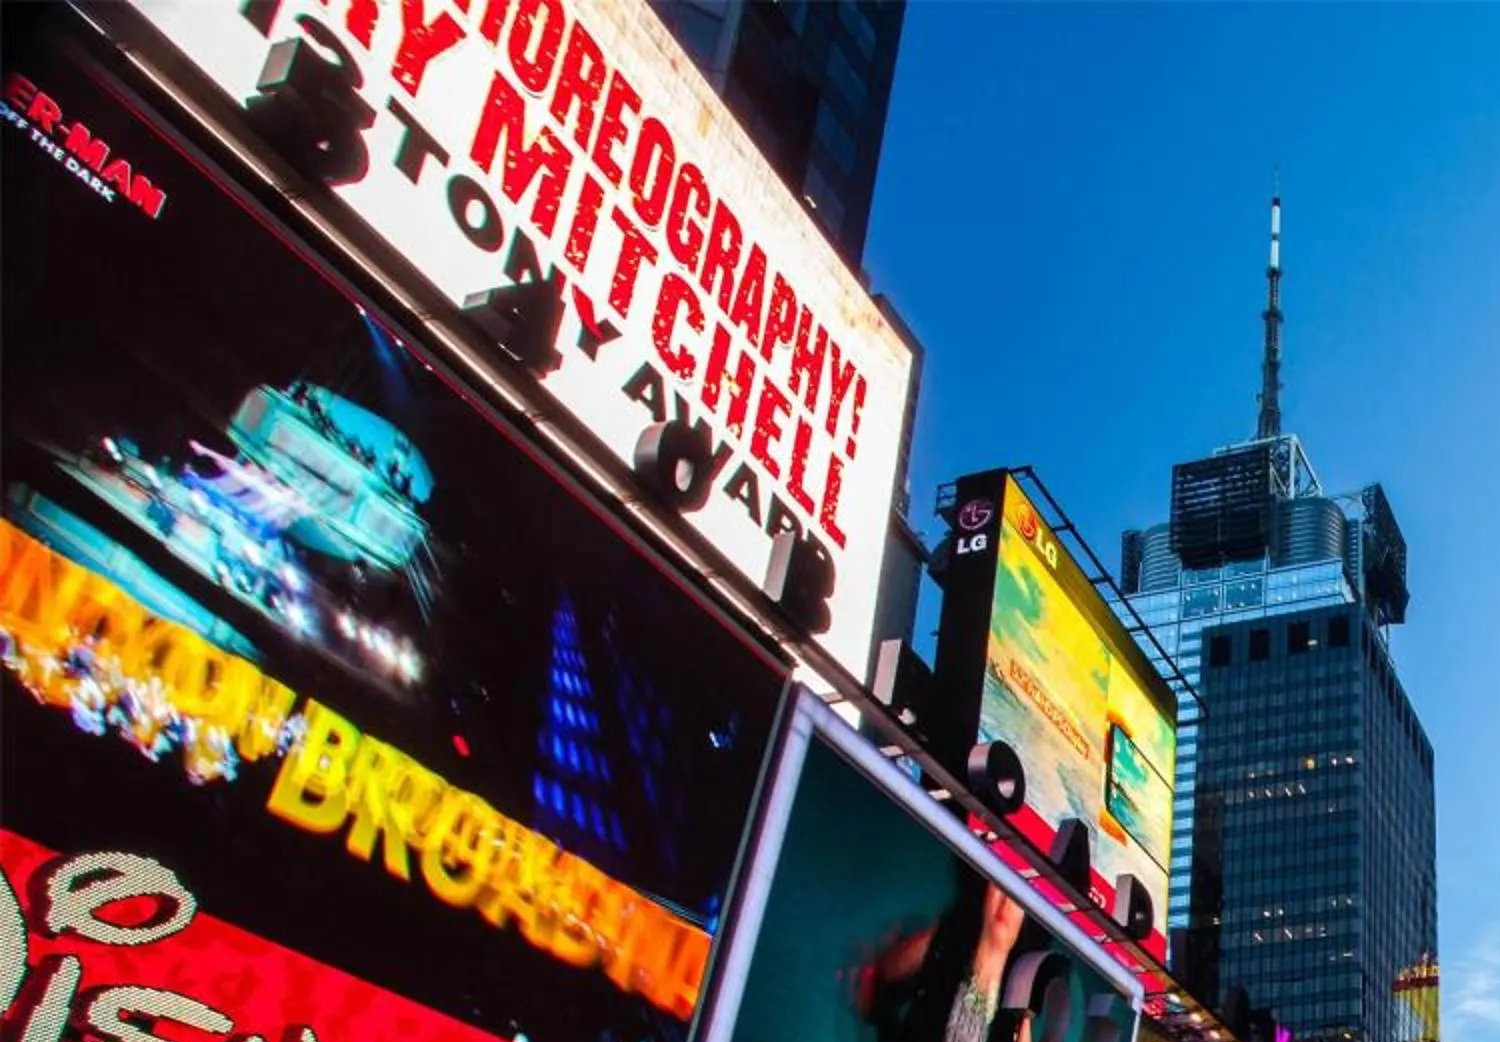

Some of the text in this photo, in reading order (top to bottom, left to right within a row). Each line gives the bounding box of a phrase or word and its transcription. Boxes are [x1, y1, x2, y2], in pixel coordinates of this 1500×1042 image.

[64, 156, 118, 203] DARK
[450, 0, 867, 461] OREOGRAPHY!
[470, 70, 847, 550] MITCHELL
[956, 533, 988, 555] LG
[1035, 526, 1058, 571] LG
